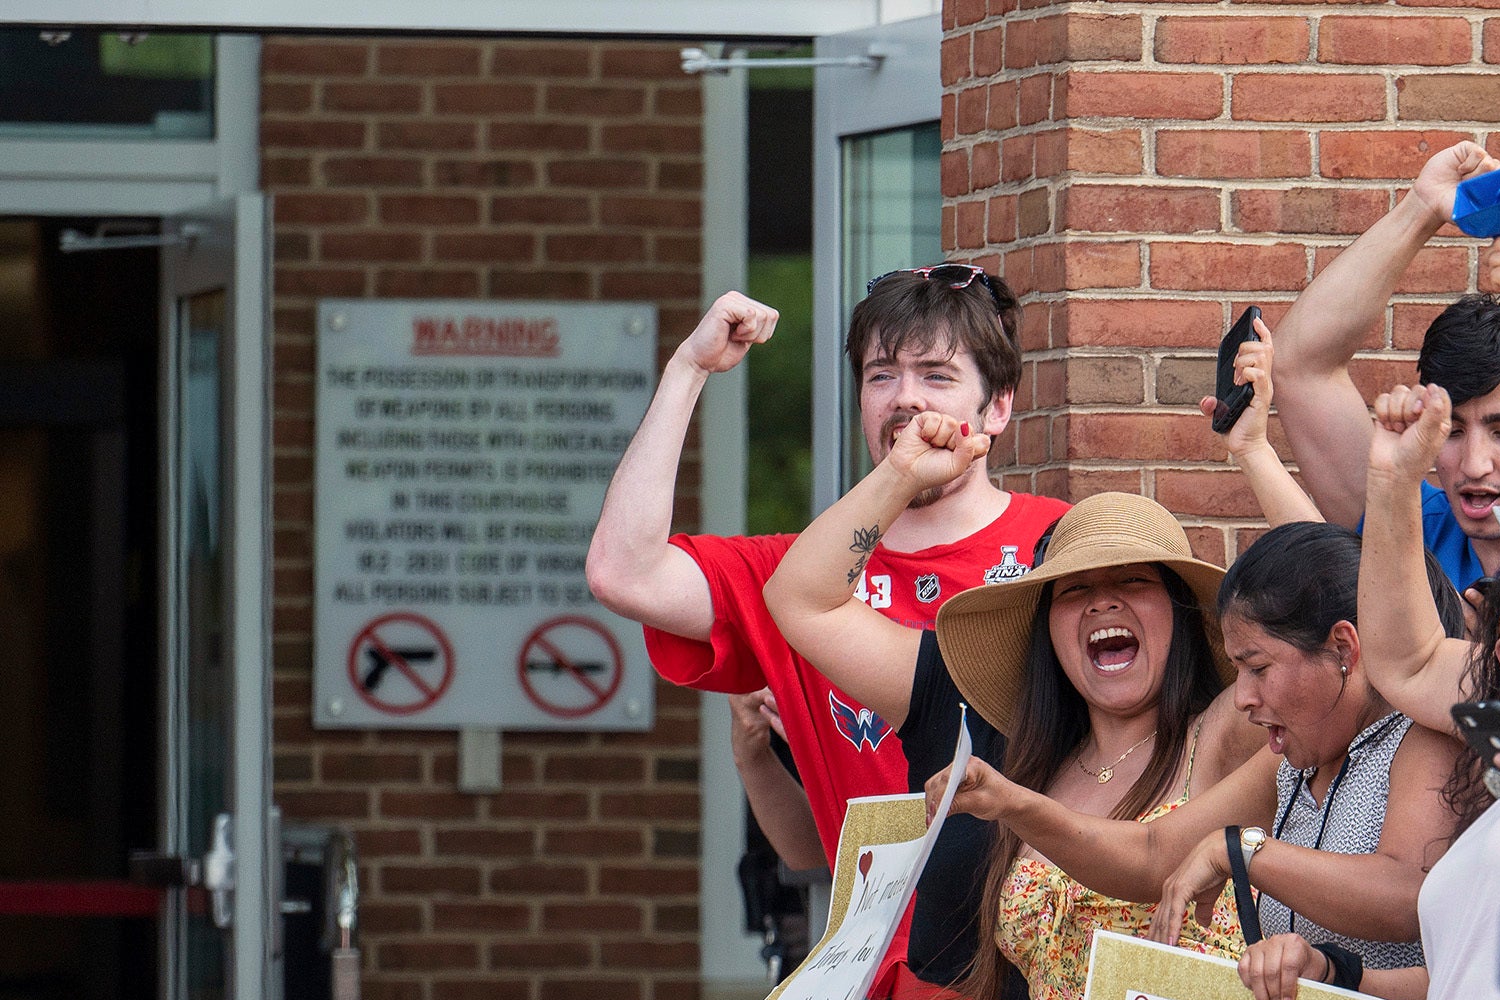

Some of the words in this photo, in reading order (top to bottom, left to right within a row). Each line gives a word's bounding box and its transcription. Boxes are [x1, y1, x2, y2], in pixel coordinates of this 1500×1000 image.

[411, 318, 560, 350] WARNING
[327, 368, 355, 386] THE
[361, 368, 468, 387] POSSESSION
[502, 369, 646, 389] TRANSPORTATION
[356, 399, 376, 416] OF
[379, 399, 463, 418] WEAPONS
[469, 399, 490, 418] BY
[496, 400, 527, 420] ALL
[336, 429, 424, 449] INCLUDING
[430, 430, 481, 449] THOSE
[487, 430, 525, 449] WITH
[345, 460, 418, 478] WEAPON
[392, 491, 409, 508] IN
[415, 491, 453, 509] THIS
[458, 491, 568, 511] COURTHOUSE
[345, 520, 437, 540] VIOLATORS
[442, 521, 479, 541] WILL
[486, 522, 507, 540] BE
[456, 552, 501, 573] CODE
[507, 553, 528, 572] OF
[334, 583, 367, 603] ALL
[372, 583, 453, 604] PERSONS
[457, 584, 533, 605] SUBJECT
[539, 585, 558, 604] TO
